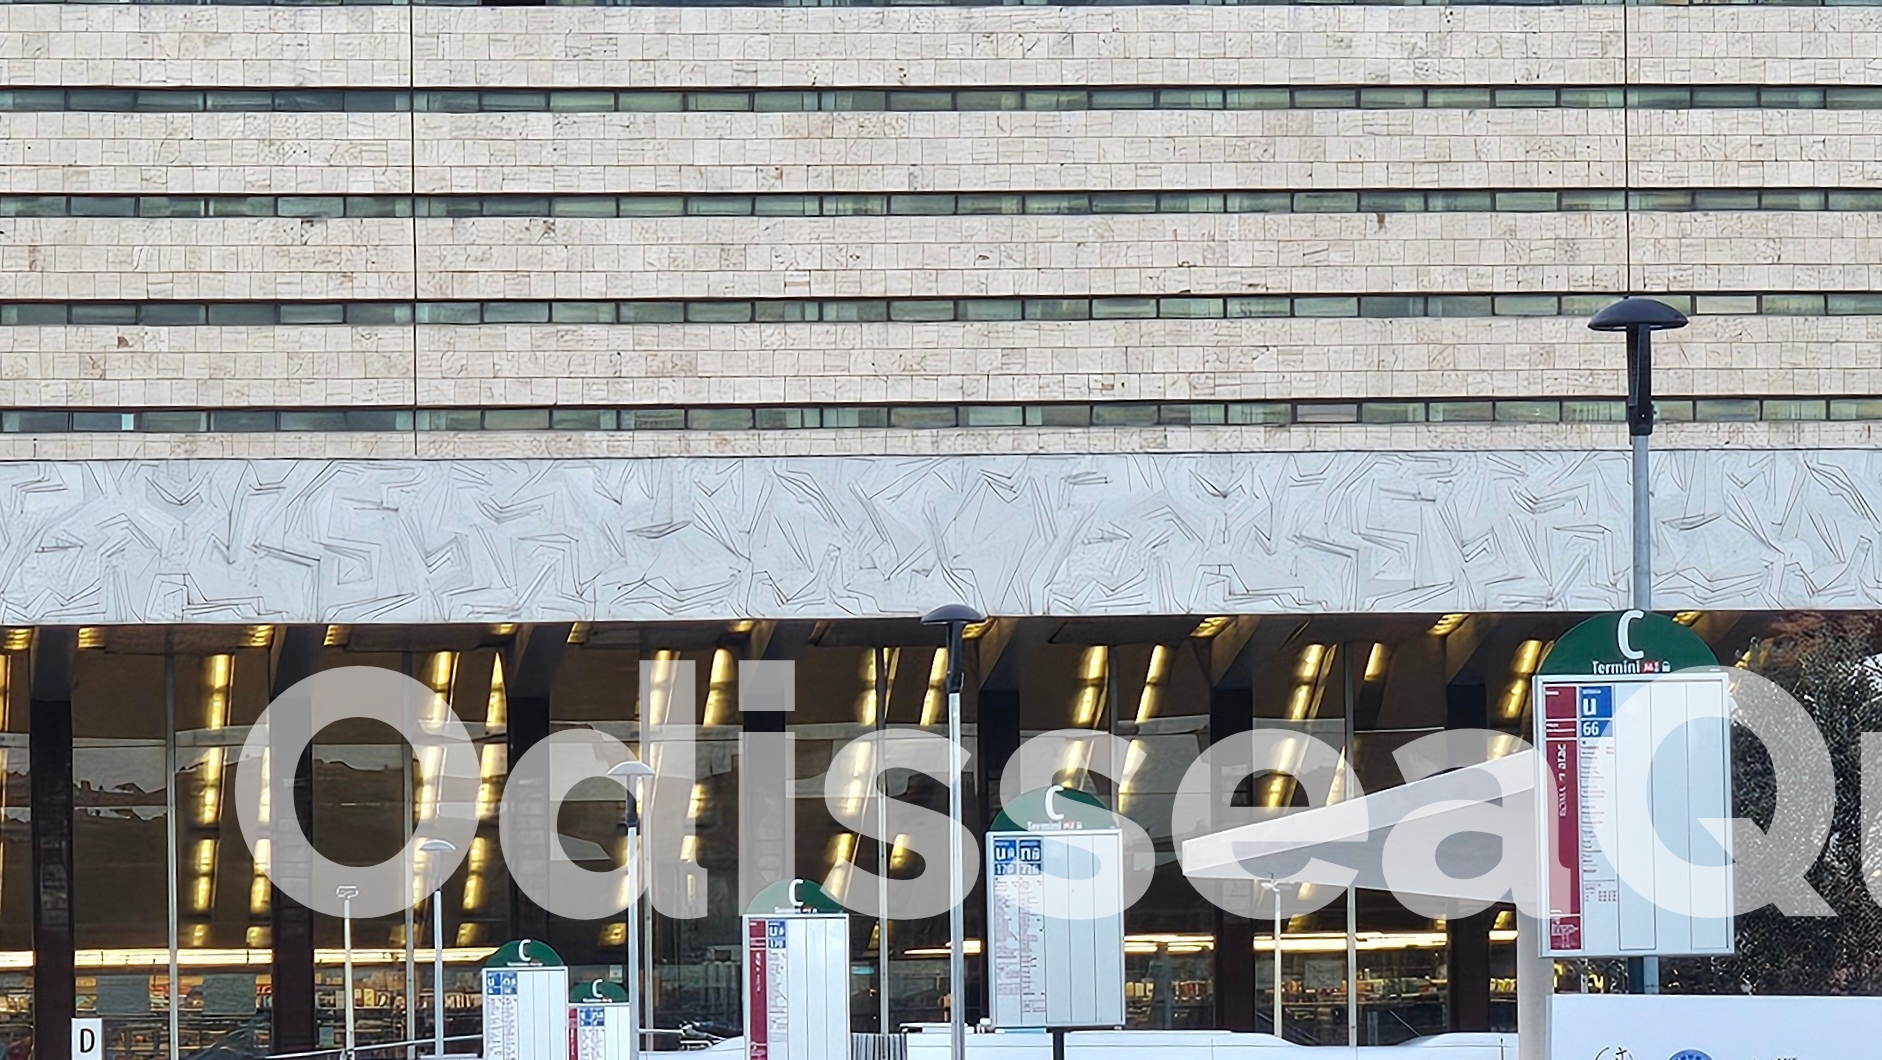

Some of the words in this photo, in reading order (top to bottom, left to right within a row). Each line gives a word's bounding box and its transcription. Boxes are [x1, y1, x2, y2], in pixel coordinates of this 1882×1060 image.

[1617, 609, 1645, 660] C
[1592, 660, 1640, 674] Termini
[1583, 721, 1600, 736] 66
[1045, 785, 1065, 820] C
[788, 879, 804, 907] C
[517, 939, 531, 962] C
[591, 979, 603, 998] C
[80, 1028, 95, 1053] D
